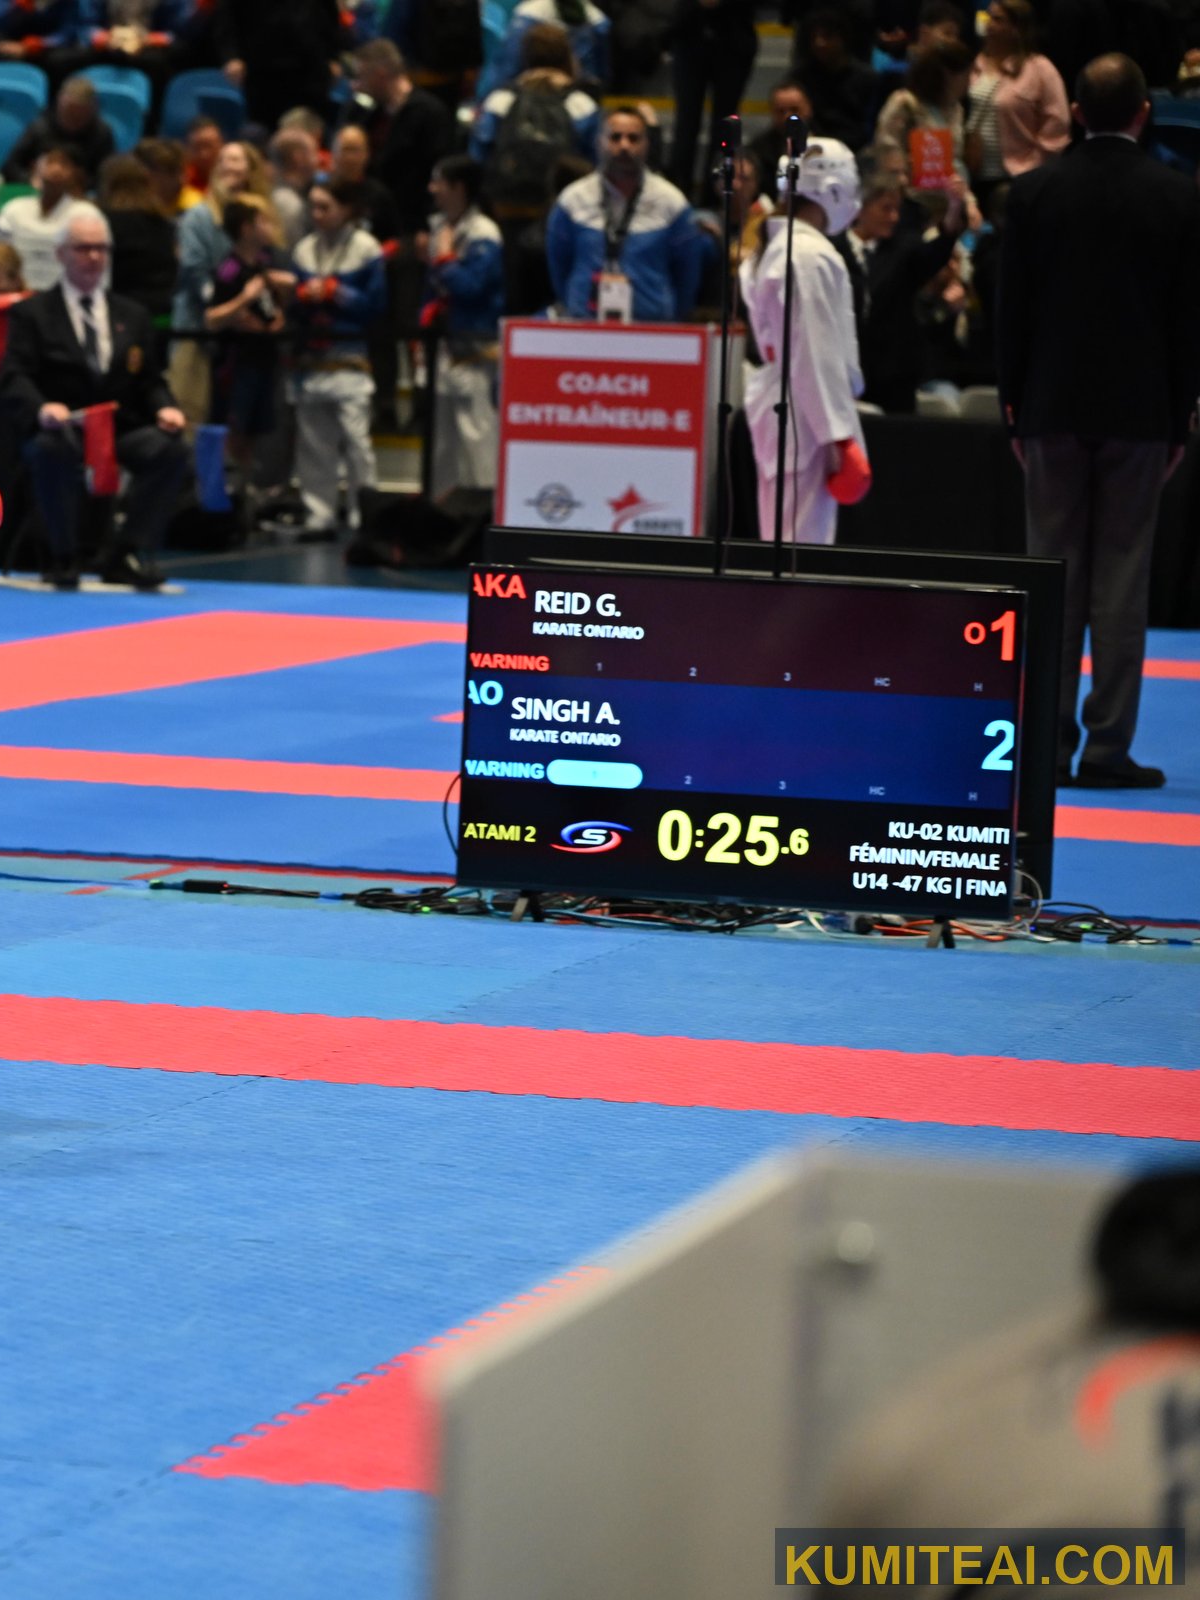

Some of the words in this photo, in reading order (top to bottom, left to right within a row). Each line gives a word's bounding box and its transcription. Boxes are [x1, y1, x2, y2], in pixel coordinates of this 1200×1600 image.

[558, 372, 649, 395] COACH
[534, 590, 591, 615] REID
[596, 593, 622, 617] G.
[532, 622, 582, 637] KARATE
[583, 624, 645, 640] ONTARIO
[990, 610, 1016, 661] 1
[595, 662, 603, 672] 1
[689, 667, 697, 677] 2
[783, 671, 792, 682] 3
[874, 677, 891, 687] HC
[973, 682, 983, 692] H
[511, 697, 590, 723] SINGH
[595, 702, 621, 725] A.
[509, 728, 559, 743] KARATE
[560, 731, 622, 747] ONTARIO
[981, 719, 1016, 771] 2
[684, 775, 693, 785] 2
[779, 780, 787, 790] 3
[869, 786, 886, 796] HC
[968, 791, 978, 801] H
[462, 822, 521, 841] ATAMI
[524, 825, 537, 842] 2
[888, 821, 943, 841] KU-02
[850, 842, 1000, 871] FÉMININ/FEMALE
[852, 872, 888, 890] U14
[892, 875, 923, 892] -47
[926, 877, 952, 894] KG
